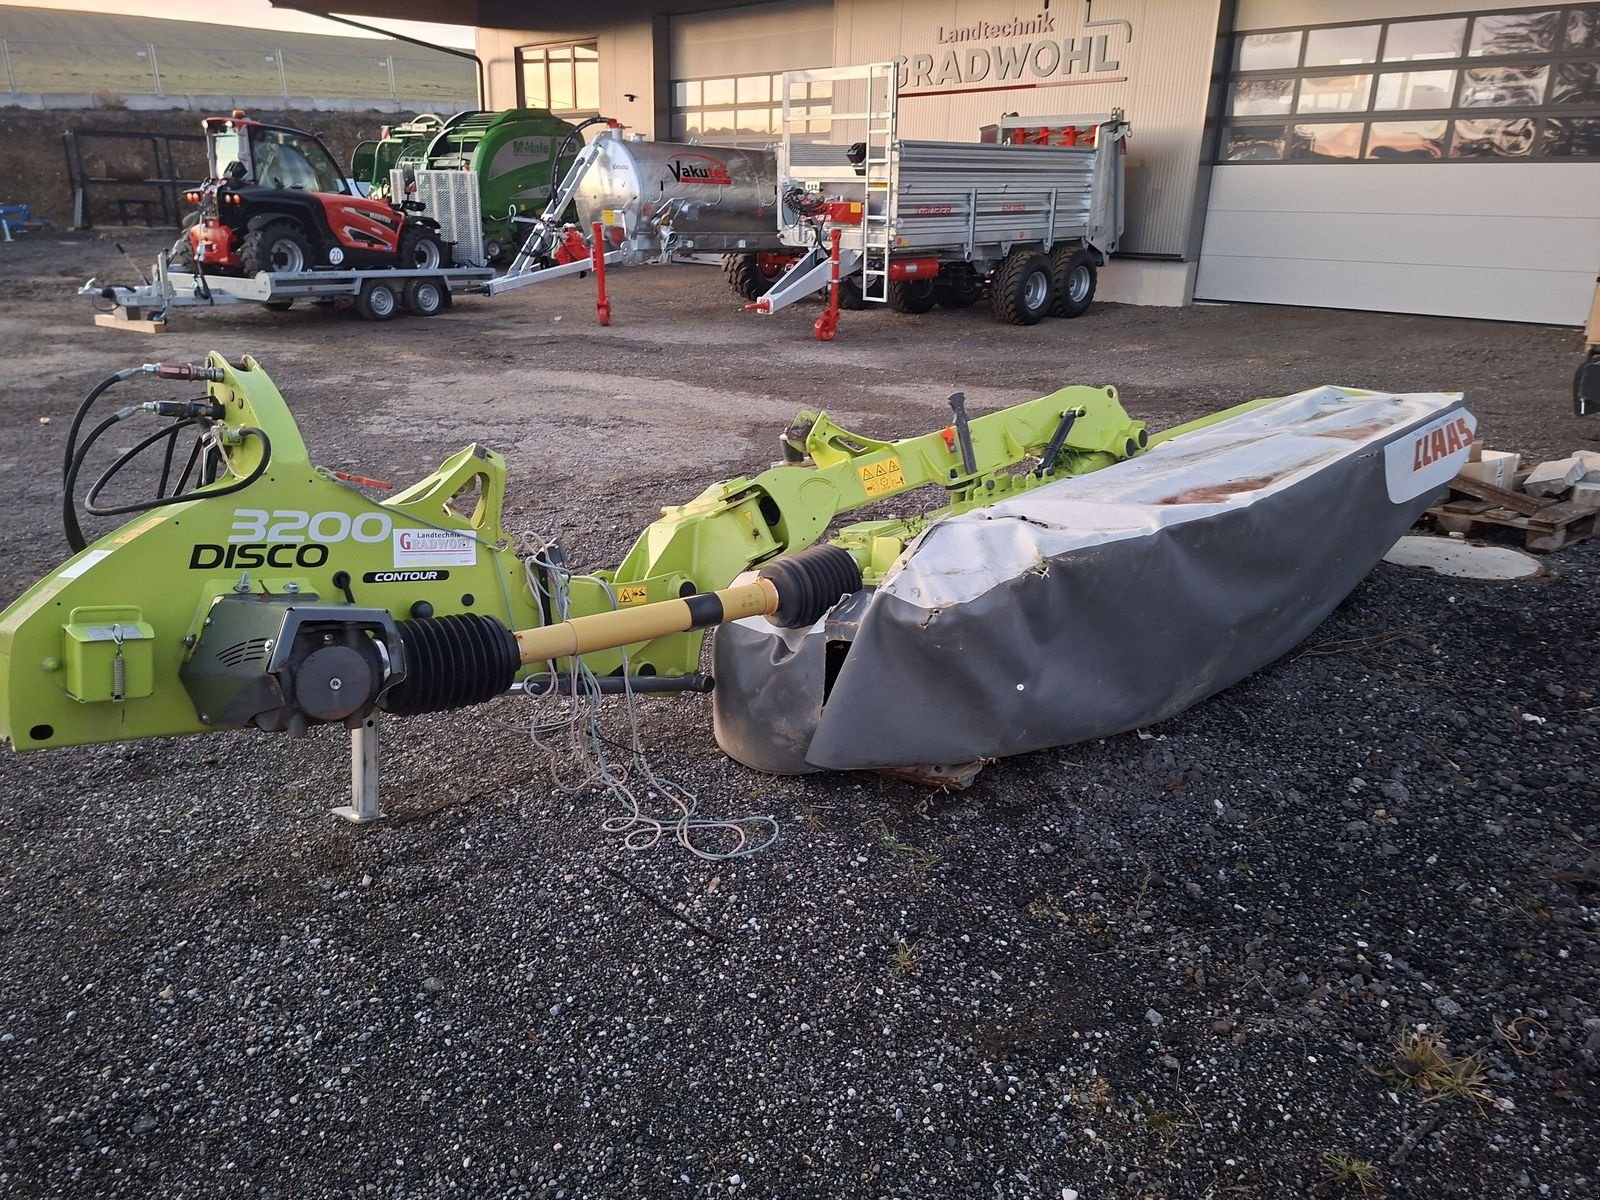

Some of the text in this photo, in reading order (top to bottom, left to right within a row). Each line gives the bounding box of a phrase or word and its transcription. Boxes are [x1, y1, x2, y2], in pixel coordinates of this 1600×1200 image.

[937, 9, 1055, 44] Landtechnik
[892, 34, 1119, 88] GRADWOHL
[331, 249, 341, 262] 20
[1412, 417, 1475, 472] CLAAS
[227, 509, 393, 543] 3200
[189, 543, 329, 569] DISCO
[375, 571, 438, 582] CONTOUR
